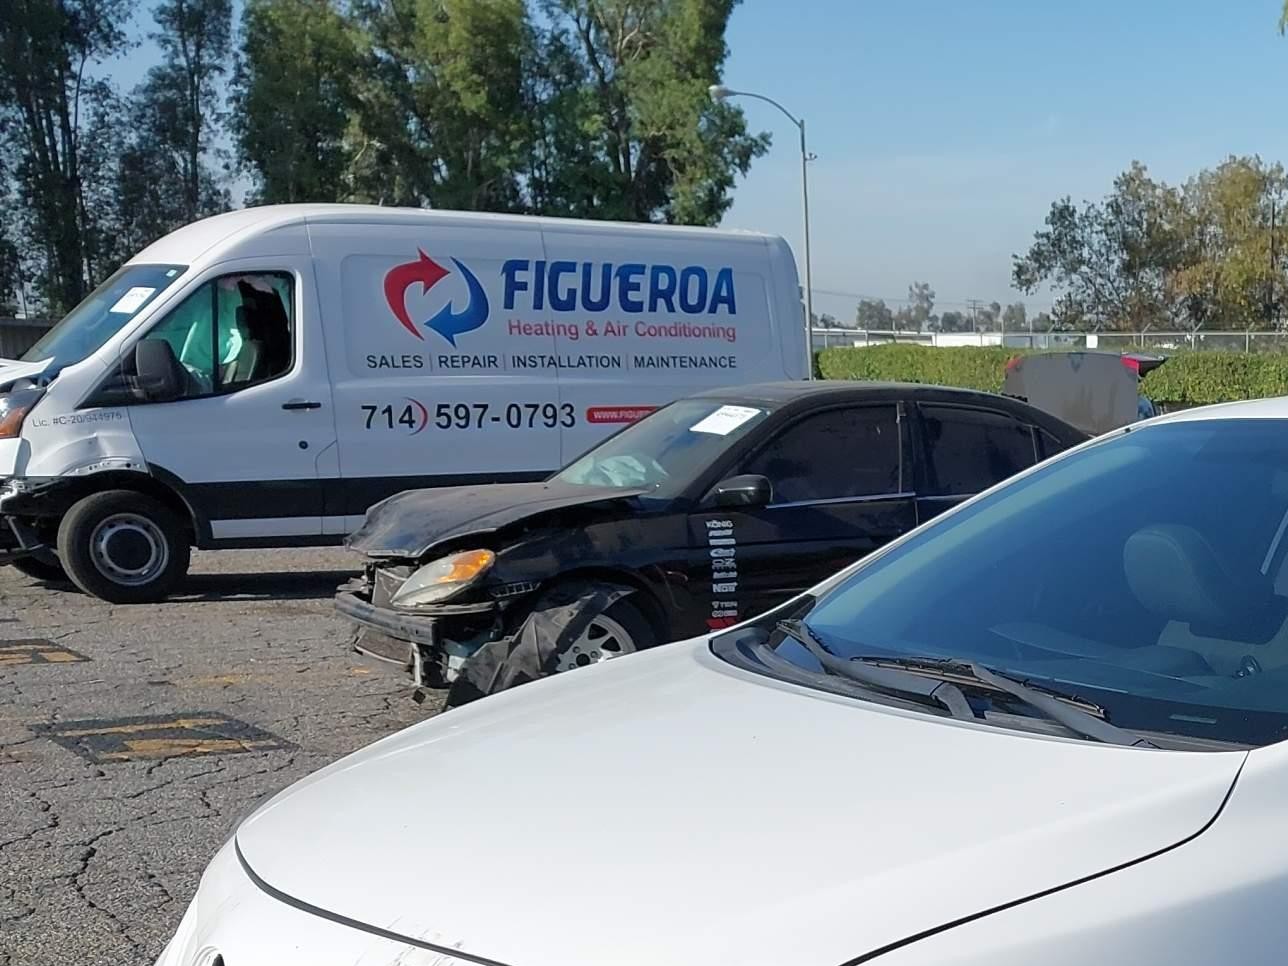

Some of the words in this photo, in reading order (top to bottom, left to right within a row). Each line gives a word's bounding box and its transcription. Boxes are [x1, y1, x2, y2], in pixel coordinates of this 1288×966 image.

[500, 258, 737, 315] FIGUEROA
[508, 319, 579, 341] Heating
[585, 320, 598, 337] &
[603, 320, 629, 338] Air
[634, 321, 737, 343] Conditioning
[366, 355, 424, 369] SALES
[438, 355, 499, 369] REPAIR
[512, 355, 621, 369] INSTALLATION
[634, 356, 737, 369] MAINTENANCE
[435, 403, 576, 429] 597-0793
